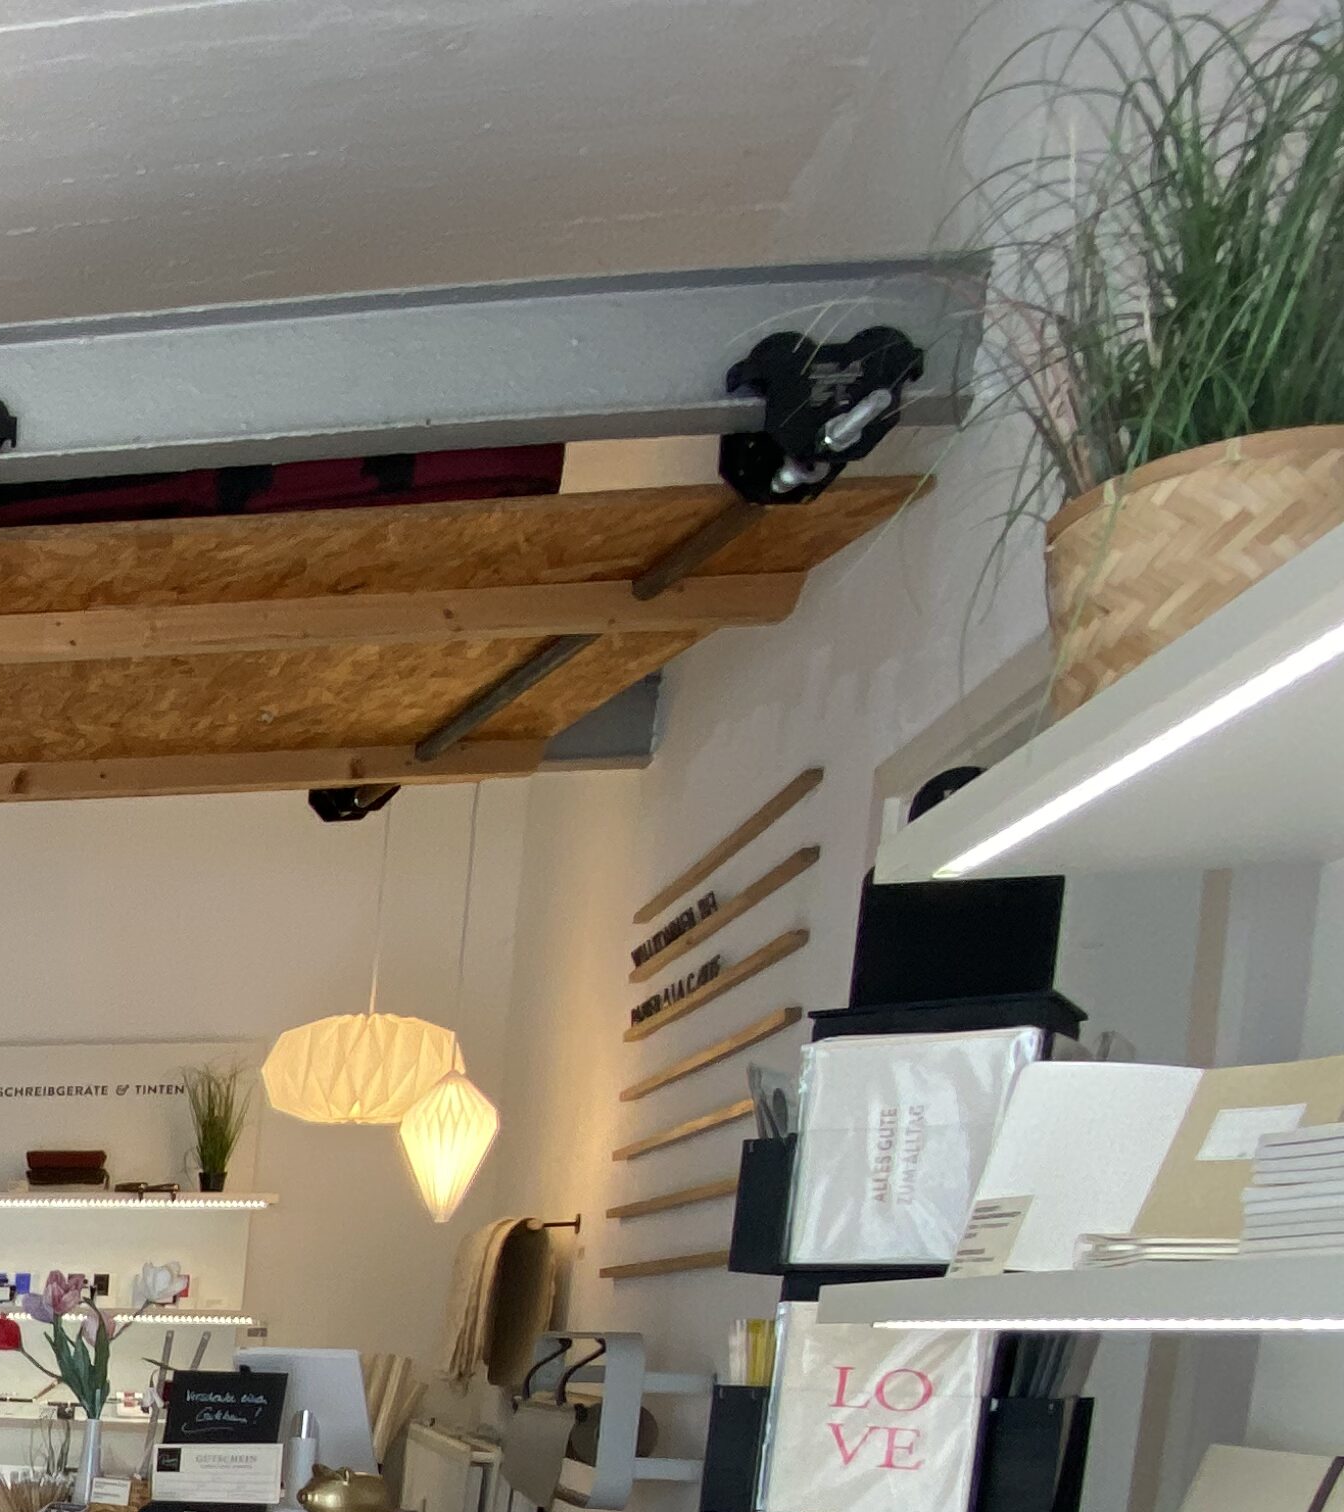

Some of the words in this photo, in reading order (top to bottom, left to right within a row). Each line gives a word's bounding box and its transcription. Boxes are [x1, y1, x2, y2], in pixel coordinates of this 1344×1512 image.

[115, 1084, 130, 1096] &
[134, 1084, 185, 1096] TINTEN
[878, 1108, 897, 1151] GUTE
[872, 1155, 892, 1202] ALLES
[829, 1366, 933, 1413] LO
[826, 1422, 924, 1471] VE
